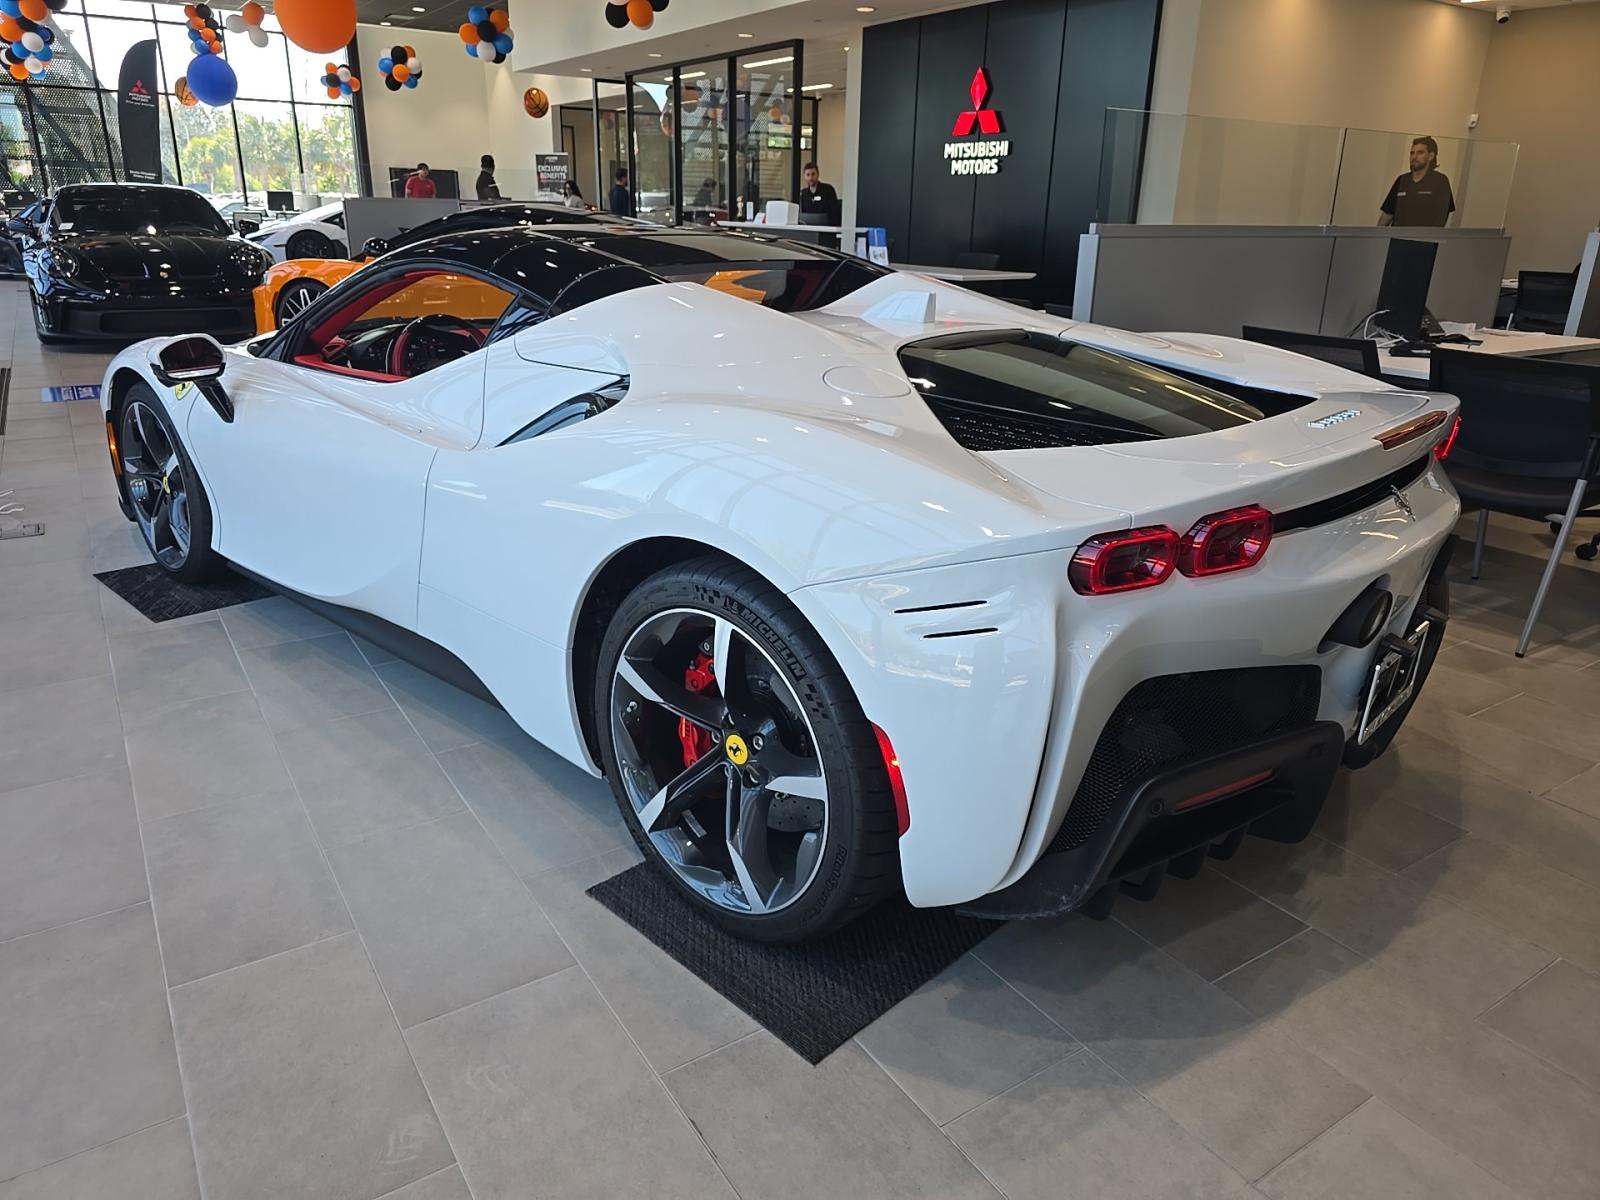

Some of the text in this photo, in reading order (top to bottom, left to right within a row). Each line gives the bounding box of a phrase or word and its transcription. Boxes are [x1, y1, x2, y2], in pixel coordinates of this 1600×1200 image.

[944, 140, 1009, 159] MITSUBISHI
[951, 158, 998, 175] MOTORS
[740, 607, 807, 681] MICHELIN
